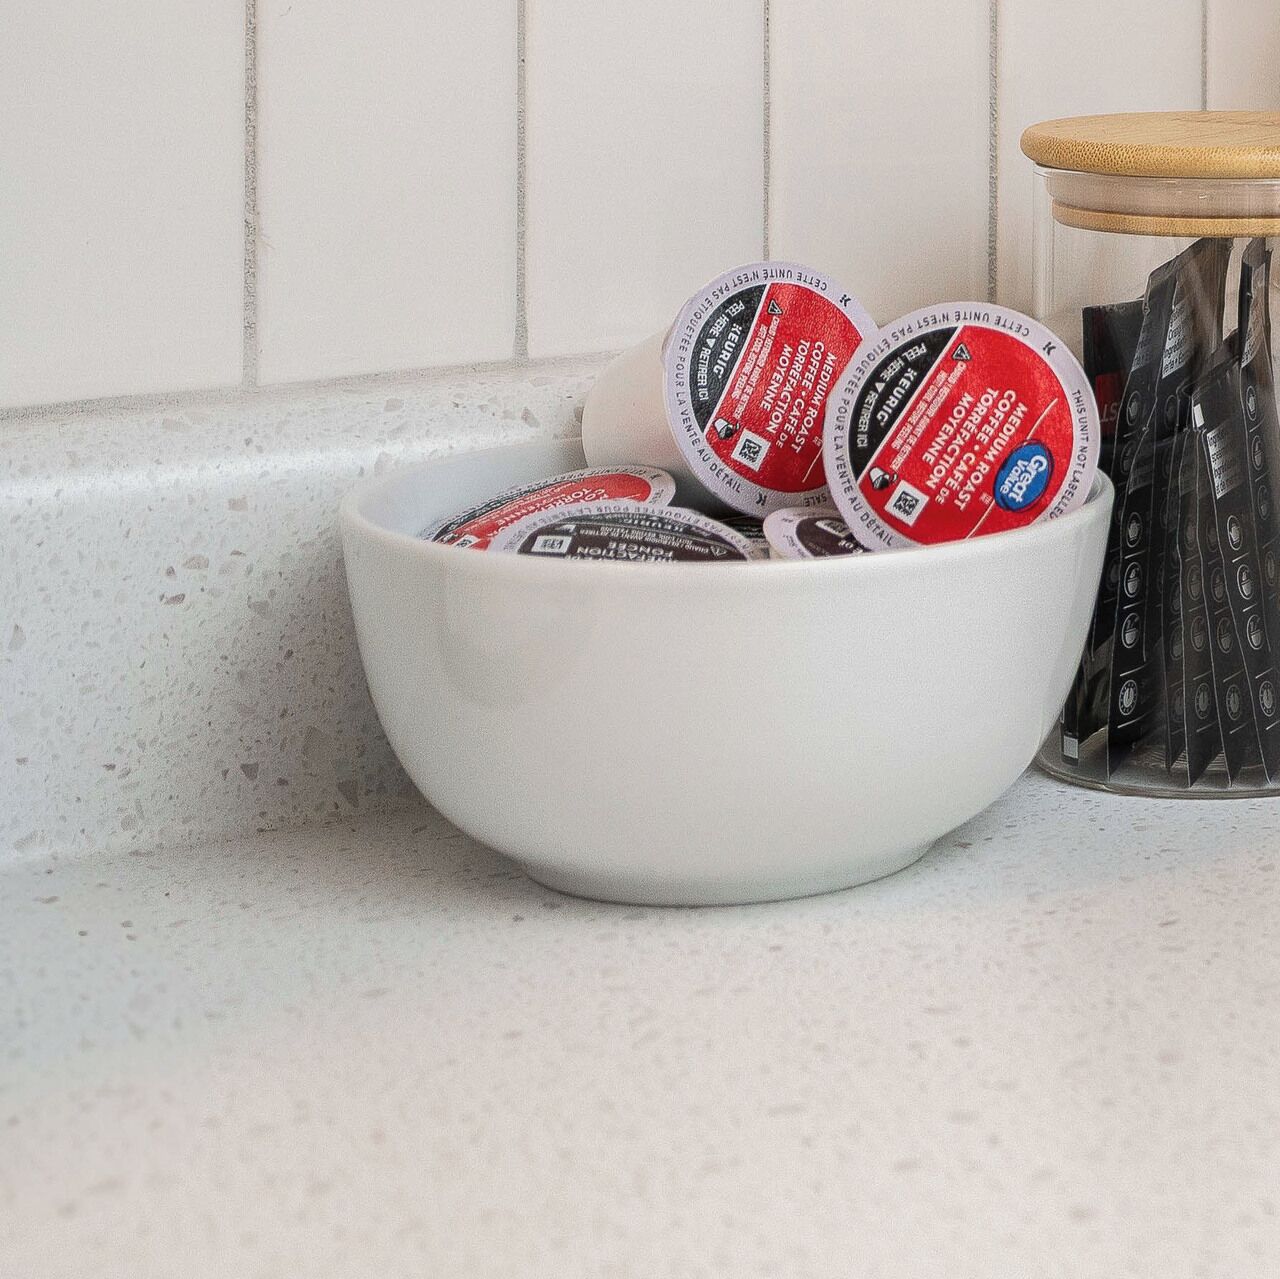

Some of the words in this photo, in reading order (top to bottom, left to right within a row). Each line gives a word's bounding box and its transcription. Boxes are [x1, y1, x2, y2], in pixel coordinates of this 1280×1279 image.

[712, 283, 730, 300] PAS
[732, 271, 759, 288] N'EST
[797, 272, 827, 291] CETTE
[725, 300, 745, 317] PEEL
[917, 312, 949, 330] N'EST
[709, 314, 729, 337] HERE
[891, 324, 913, 341] PAS
[995, 315, 1030, 336] CETTE
[713, 323, 742, 377] KEURIG
[798, 339, 828, 389] COFFEE
[902, 343, 927, 361] PEEL
[675, 355, 686, 387] POUR
[697, 347, 711, 386] RETIRER
[758, 343, 795, 412] MOYENNE
[807, 351, 840, 406] MEDIUM
[880, 357, 905, 381] HERE
[676, 391, 686, 406] LA
[698, 387, 709, 400] ICI
[764, 337, 816, 435] TORRÉFACTION
[876, 368, 917, 423] KEURIG
[1072, 389, 1087, 414] THIS
[680, 409, 701, 447] VENTE
[782, 396, 808, 434] CAFÉ
[834, 399, 849, 431] POUR
[858, 391, 878, 435] RETIRER
[920, 391, 976, 465] MOYENNE
[974, 387, 1019, 445] COFFEE
[774, 431, 788, 449] DE
[788, 405, 818, 454] ROAST
[834, 435, 844, 450] LA
[922, 384, 1003, 492] TORRÉFACTION
[982, 401, 1030, 463] MEDIUM
[1077, 417, 1089, 442] UNIT
[697, 448, 711, 462] AU
[943, 449, 980, 493] CAFÉ
[1076, 445, 1089, 469] NOT
[709, 463, 741, 493] DÉTAIL
[835, 455, 853, 494] VENTE
[950, 459, 991, 511] ROAST
[1000, 459, 1028, 494] Value
[1008, 455, 1048, 503] Great
[803, 493, 827, 507] SALE
[849, 497, 862, 512] AU
[933, 485, 950, 505] DE
[860, 512, 892, 547] DÉTAIL
